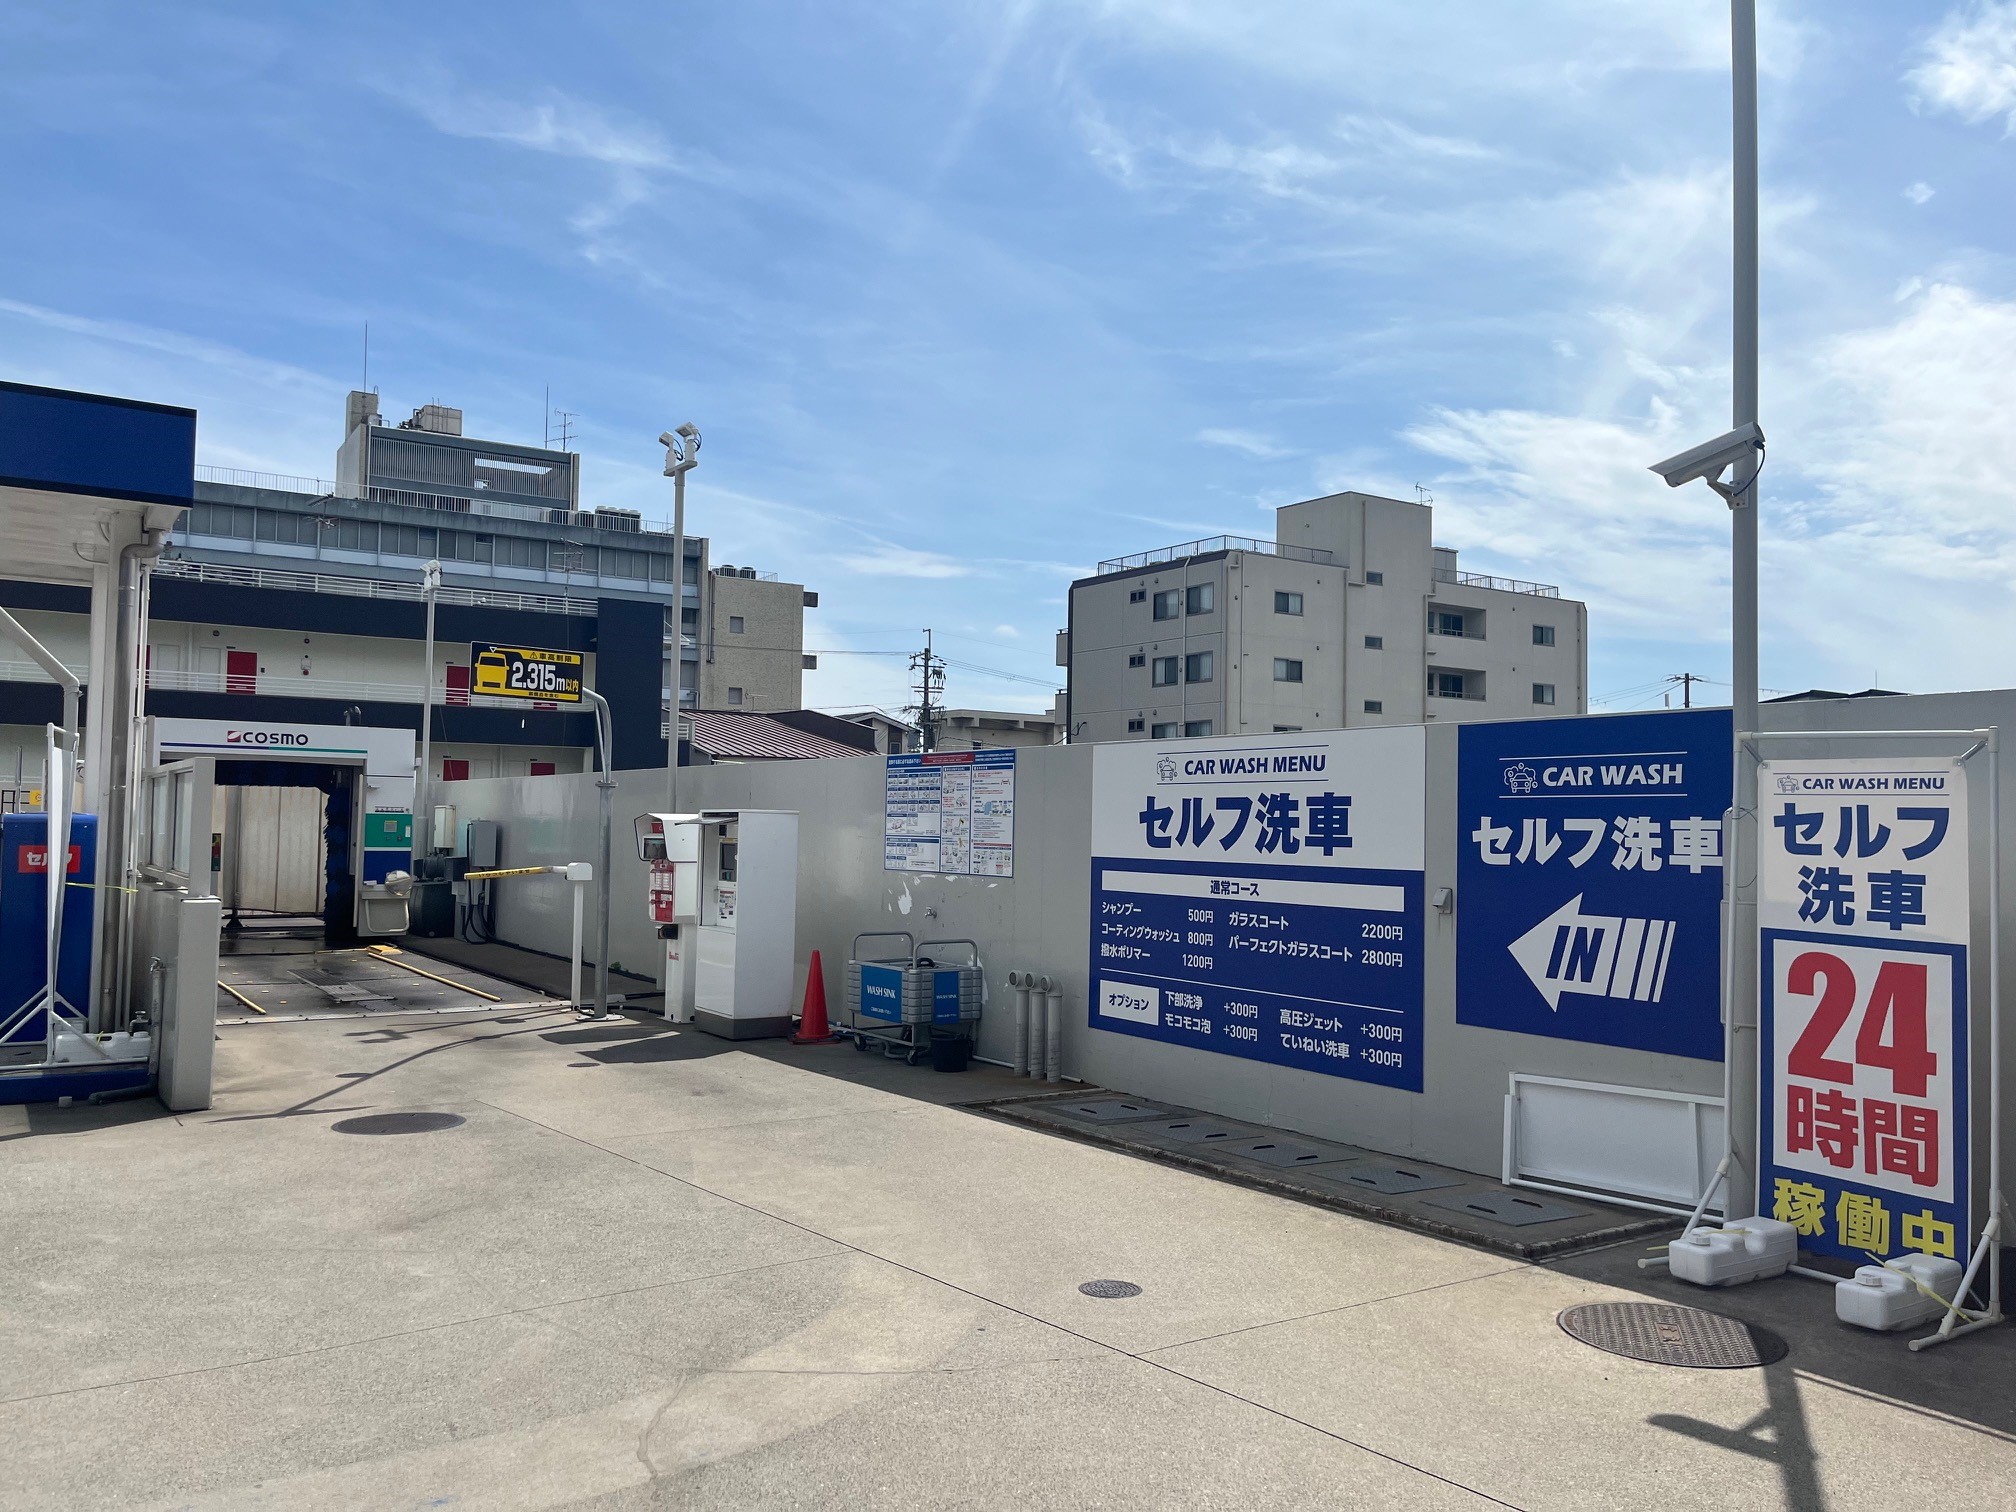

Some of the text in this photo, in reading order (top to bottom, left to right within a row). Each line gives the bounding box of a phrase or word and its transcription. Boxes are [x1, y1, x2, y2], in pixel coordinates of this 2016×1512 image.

[539, 652, 572, 663] 車高制限
[243, 731, 308, 745] COSMO
[1184, 755, 1326, 775] CAR WASH MENU
[1542, 763, 1683, 787] CAR WASH
[1802, 777, 1945, 790] CAR WASH MENU
[1139, 792, 1353, 856] セルフ洗車
[1773, 802, 1950, 861] セルフ
[1472, 816, 1723, 874] セルフ洗車
[1210, 880, 1260, 897] 通常コース
[1797, 864, 1927, 931] 洗車
[1102, 902, 1214, 923] シャンプー 500円
[1229, 911, 1403, 941] ガラスコート 2200円
[1101, 923, 1214, 947] コーティングウォッシュ 800円
[1100, 943, 1213, 970] 撥水ポリマー 1200円
[1228, 935, 1403, 968] パーフェクトガラスコート 2800円
[1545, 925, 1606, 984] IN
[866, 985, 896, 999] WASH SINK
[1109, 993, 1150, 1011] オプション
[1165, 990, 1258, 1019] 下部洗浄 +300円
[1165, 1013, 1258, 1042] モコモコ泡 +300円
[1280, 1008, 1403, 1043] 高圧ジェット +300円
[1787, 951, 1938, 1098] 24
[1280, 1033, 1402, 1068] ていねい洗車 +300円
[1787, 1084, 1939, 1188] 時間
[1772, 1177, 1955, 1258] 稼働中
